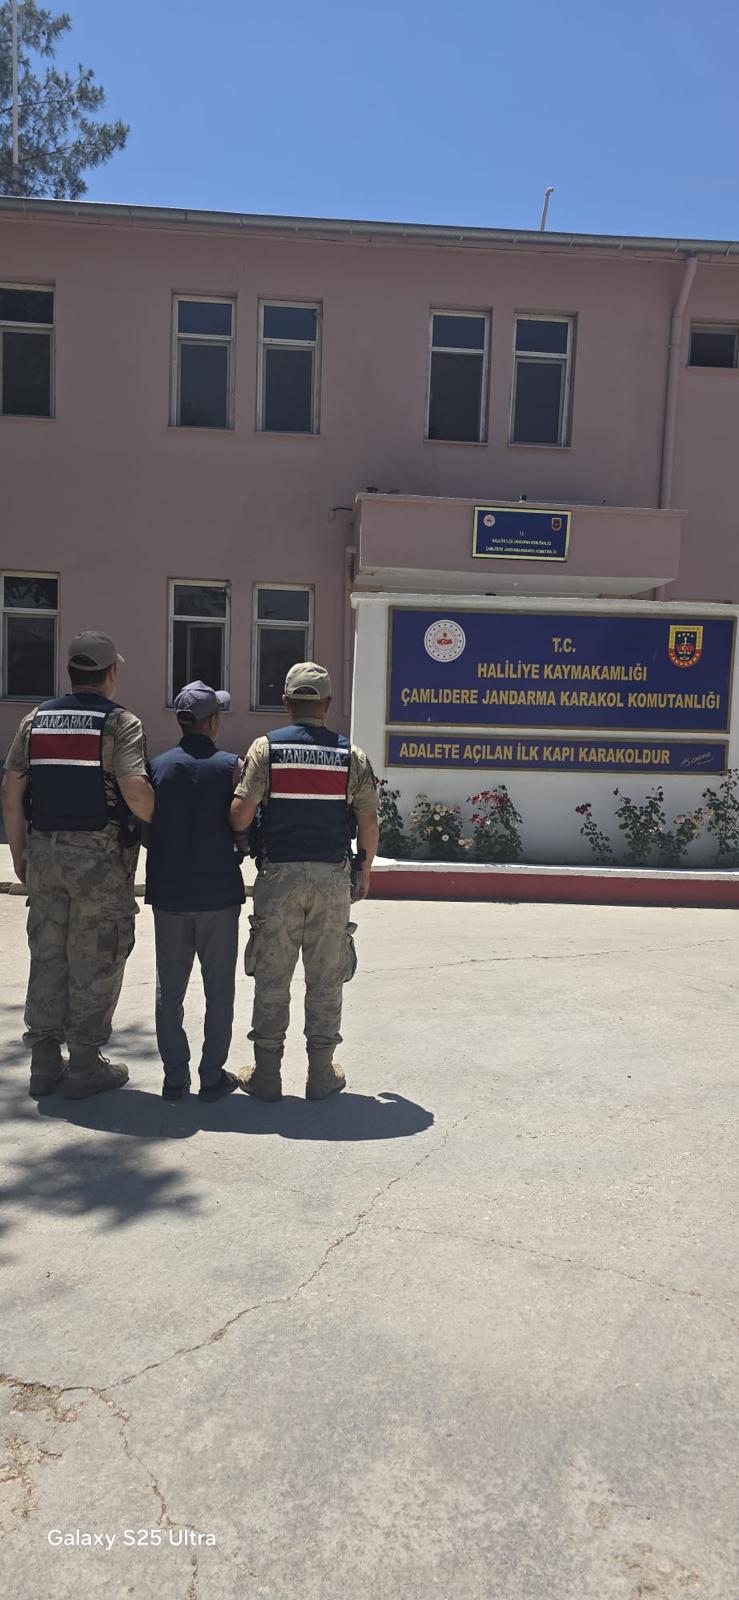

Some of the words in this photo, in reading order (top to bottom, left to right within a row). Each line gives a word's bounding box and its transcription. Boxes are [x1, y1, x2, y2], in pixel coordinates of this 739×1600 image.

[552, 637, 576, 653] T.C.
[477, 660, 540, 679] HALİLİYE
[543, 663, 648, 681] KAYMAKAMLIĞI
[401, 688, 479, 706] ÇAMLIDERE
[482, 690, 557, 706] JANDARMA
[560, 691, 625, 707] KARAKOL
[628, 691, 720, 709] KOMUTANLIĞI
[37, 715, 93, 729] JANDARMA
[279, 749, 342, 766] JANDARMA
[400, 743, 460, 759] ADALETE
[463, 745, 513, 763] AÇILAN
[517, 742, 539, 761] İLK
[543, 746, 575, 762] KAPI
[578, 747, 670, 764] KARAKOLDUR
